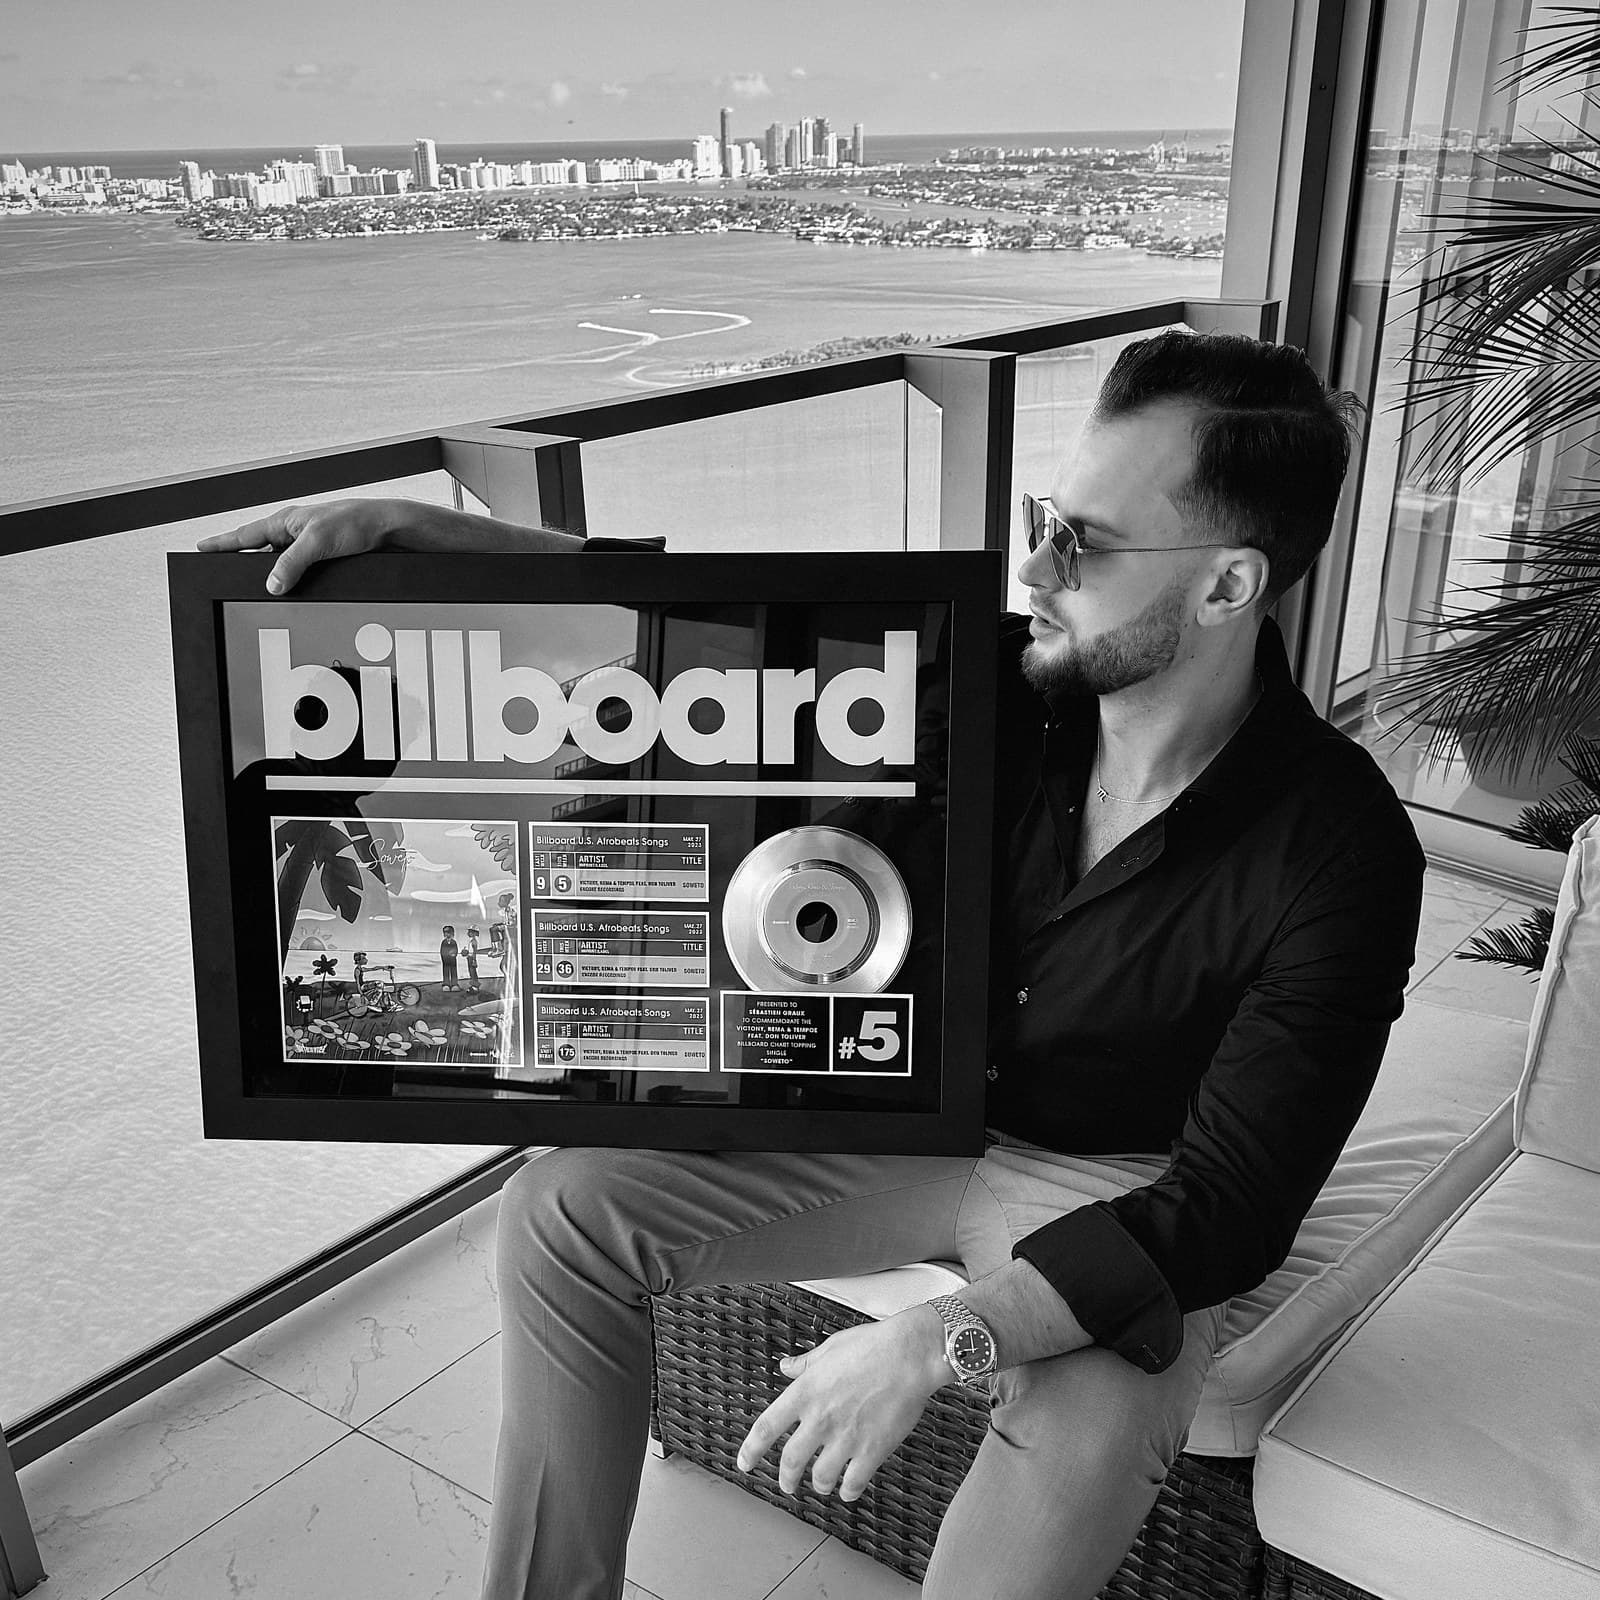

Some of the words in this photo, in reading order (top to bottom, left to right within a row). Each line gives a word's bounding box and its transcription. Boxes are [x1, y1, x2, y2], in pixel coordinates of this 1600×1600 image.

[258, 623, 917, 765] billboard
[536, 836, 576, 844] Billboard
[578, 837, 594, 845] U.S.
[596, 837, 640, 846] Afrobeats
[641, 838, 669, 848] Songs
[682, 856, 702, 864] TITLE
[536, 876, 546, 890] 9
[558, 877, 567, 890] 5
[539, 923, 578, 931] Billboard
[580, 923, 596, 932] U.S.
[599, 924, 641, 932] Afrobeats
[643, 924, 670, 934] Songs
[537, 964, 551, 974] 29
[558, 964, 572, 974] 36
[541, 1007, 580, 1015] Billboard
[582, 1007, 597, 1016] U.S.
[600, 1008, 642, 1016] Afrobeats
[644, 1008, 671, 1018] Songs
[838, 1011, 900, 1061] #5
[560, 1048, 575, 1056] 175
